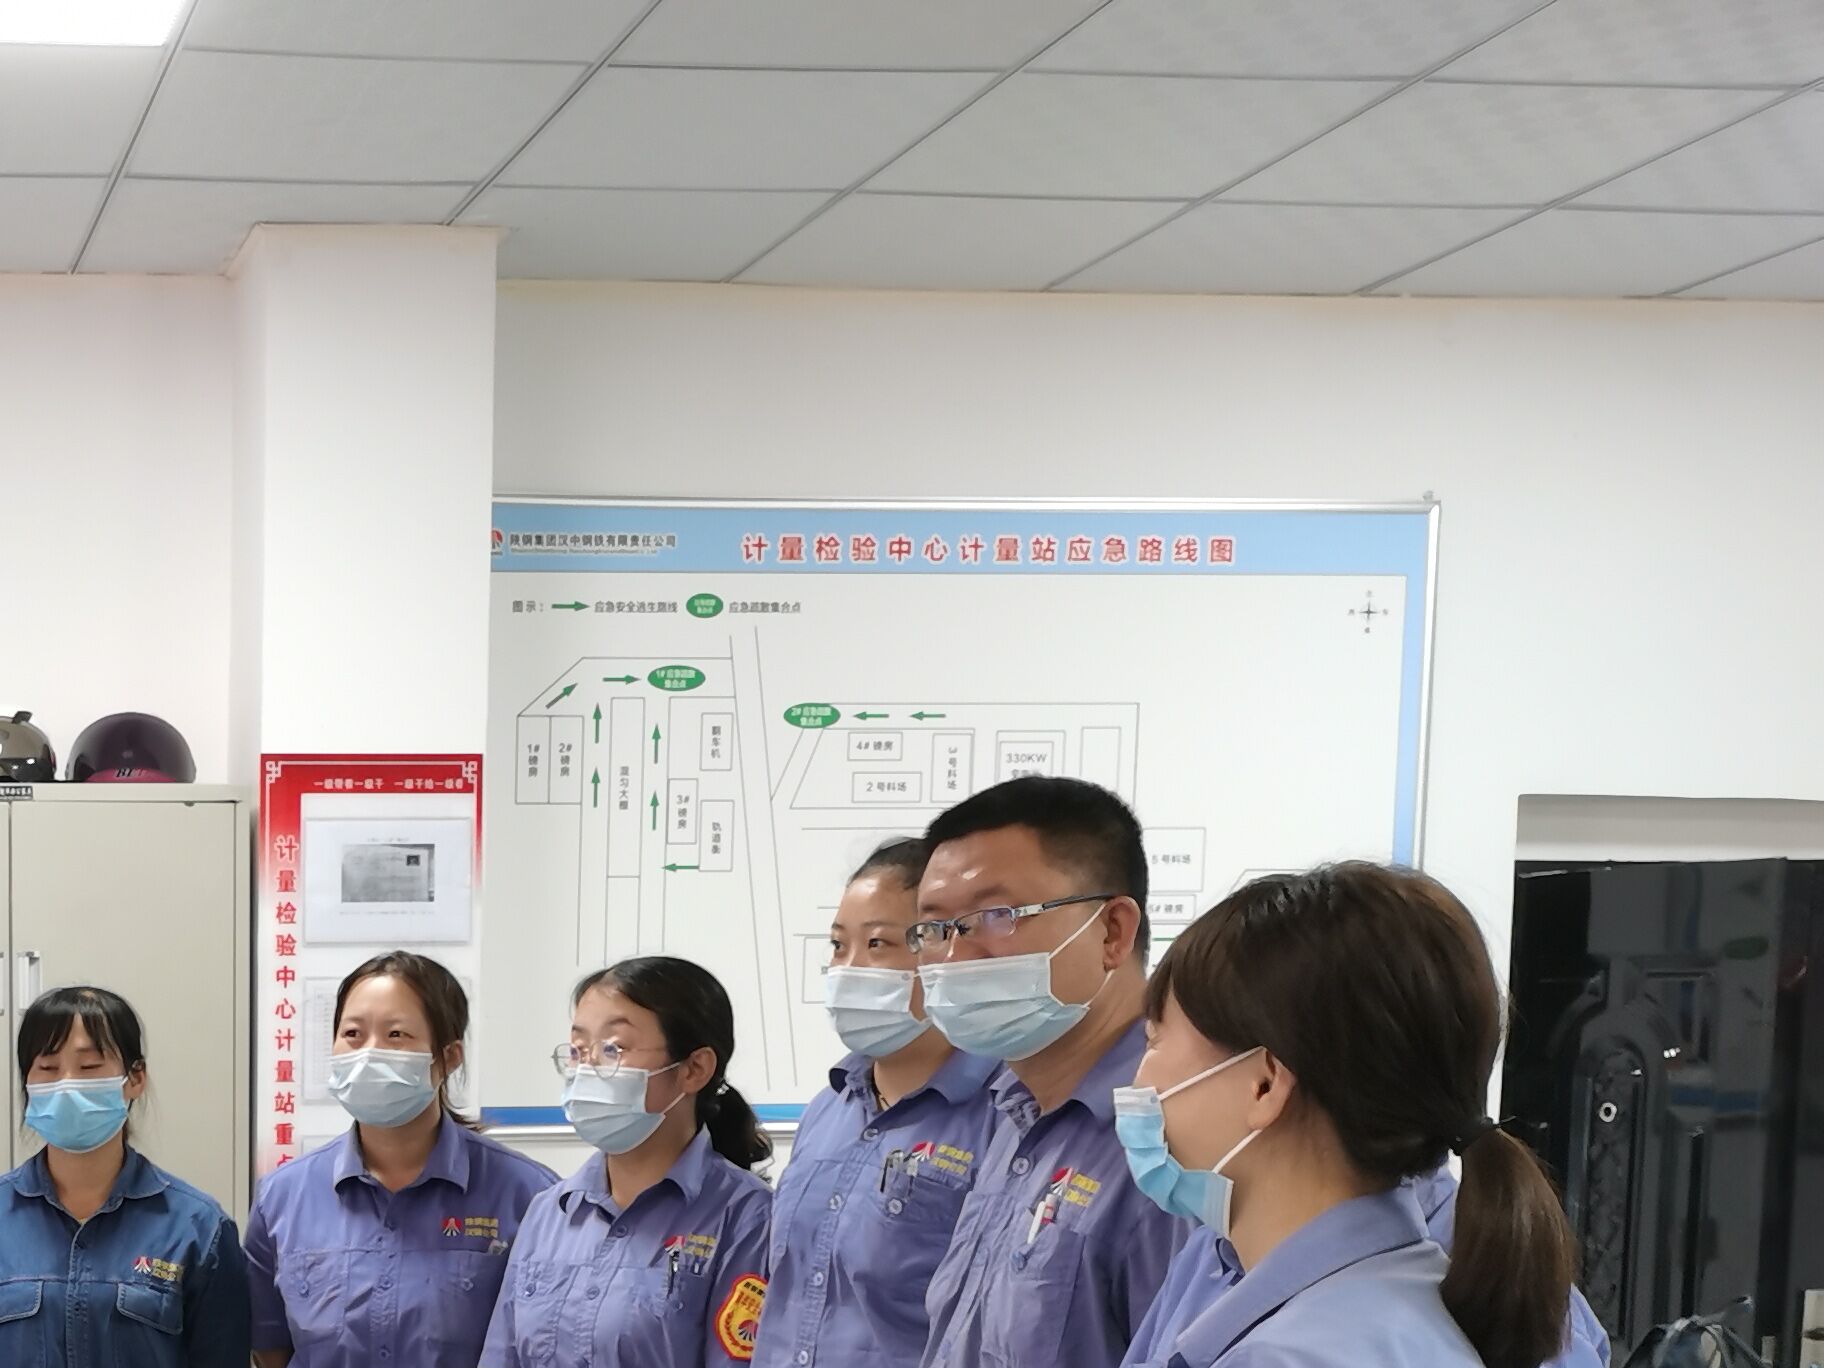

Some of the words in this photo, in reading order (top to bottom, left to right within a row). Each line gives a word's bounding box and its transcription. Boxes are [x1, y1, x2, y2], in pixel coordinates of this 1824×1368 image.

[743, 535, 1236, 563] 计量检验中心计量站应急路线图
